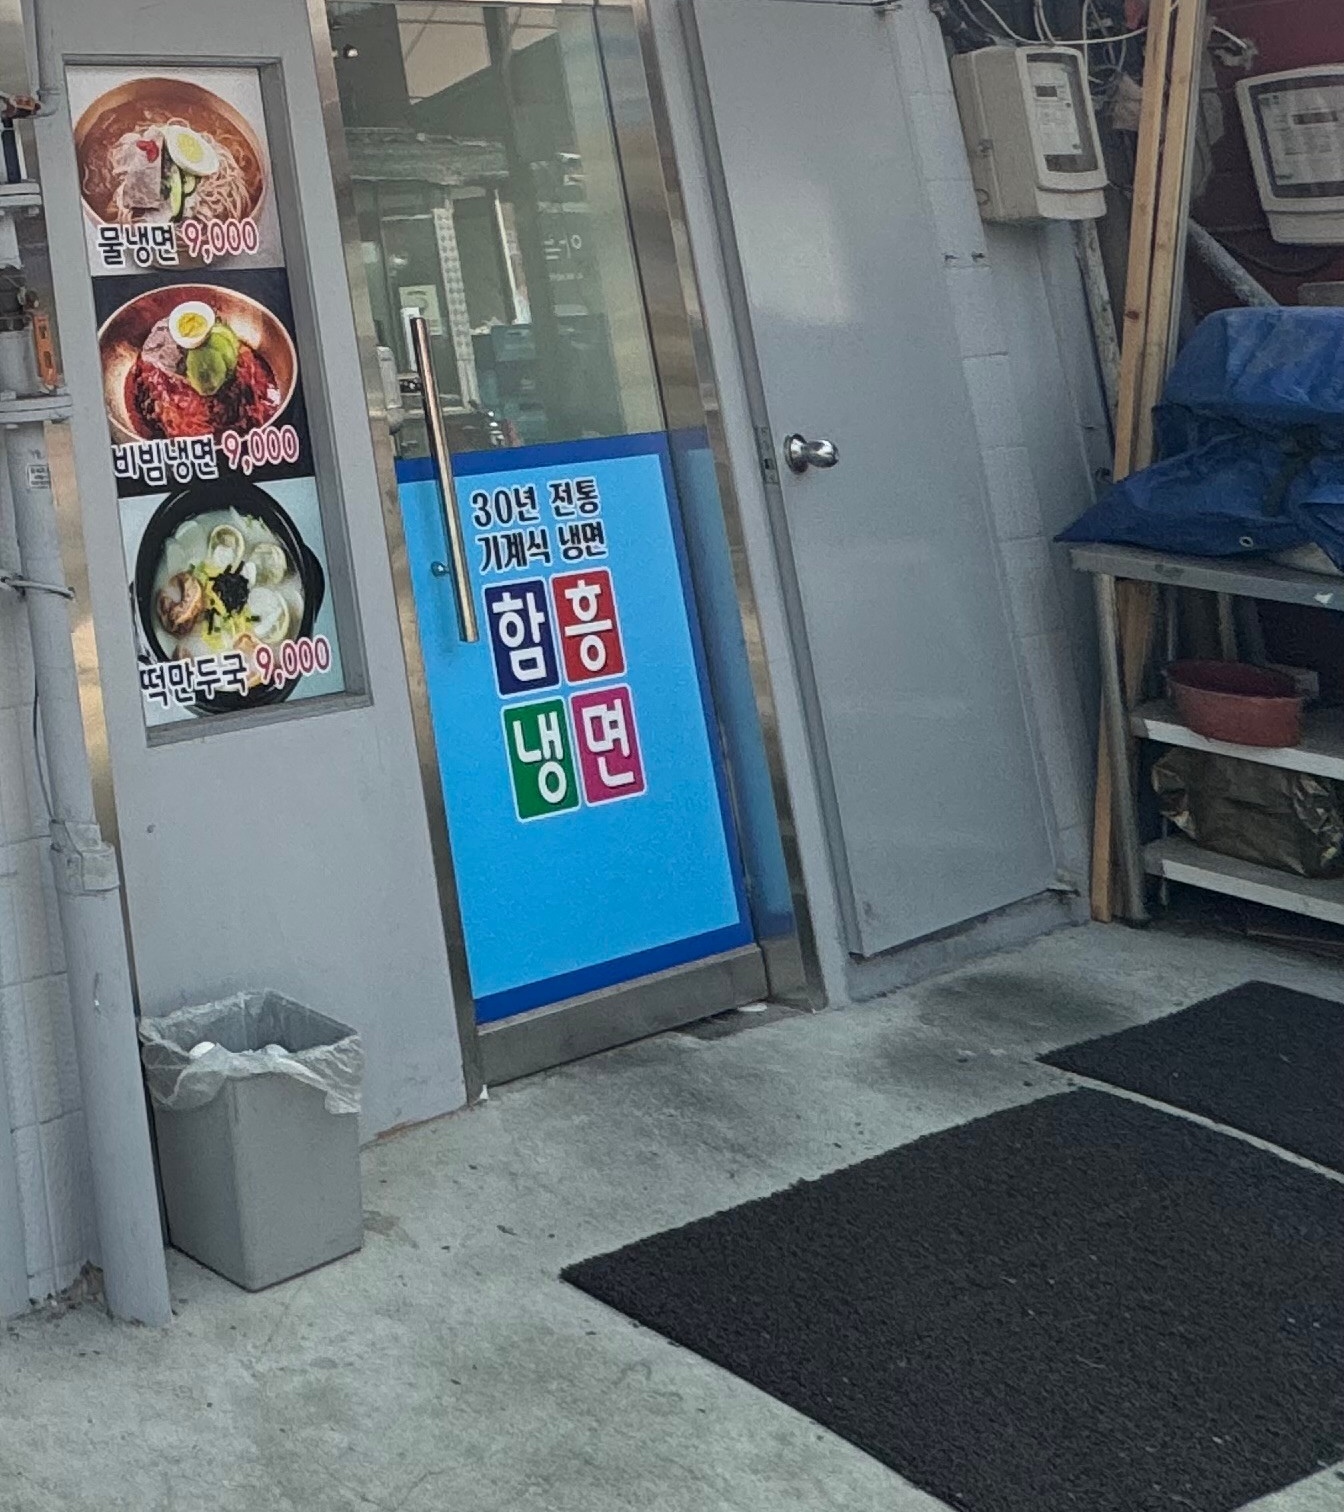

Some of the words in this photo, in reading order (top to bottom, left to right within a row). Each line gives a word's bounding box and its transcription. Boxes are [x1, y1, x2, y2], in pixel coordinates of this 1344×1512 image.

[98, 222, 179, 267] 물냉면
[182, 218, 259, 264] 9,000
[111, 433, 219, 486] 비빔냉면
[221, 424, 300, 476] 9,000
[471, 483, 540, 530] 30년
[547, 476, 602, 519] 전통
[475, 526, 552, 575] 기계식
[558, 519, 608, 563] 냉면
[492, 579, 612, 682] 함흥
[138, 651, 249, 710] 떡만두국
[255, 634, 332, 689] 9,000
[512, 698, 636, 805] 냉면
